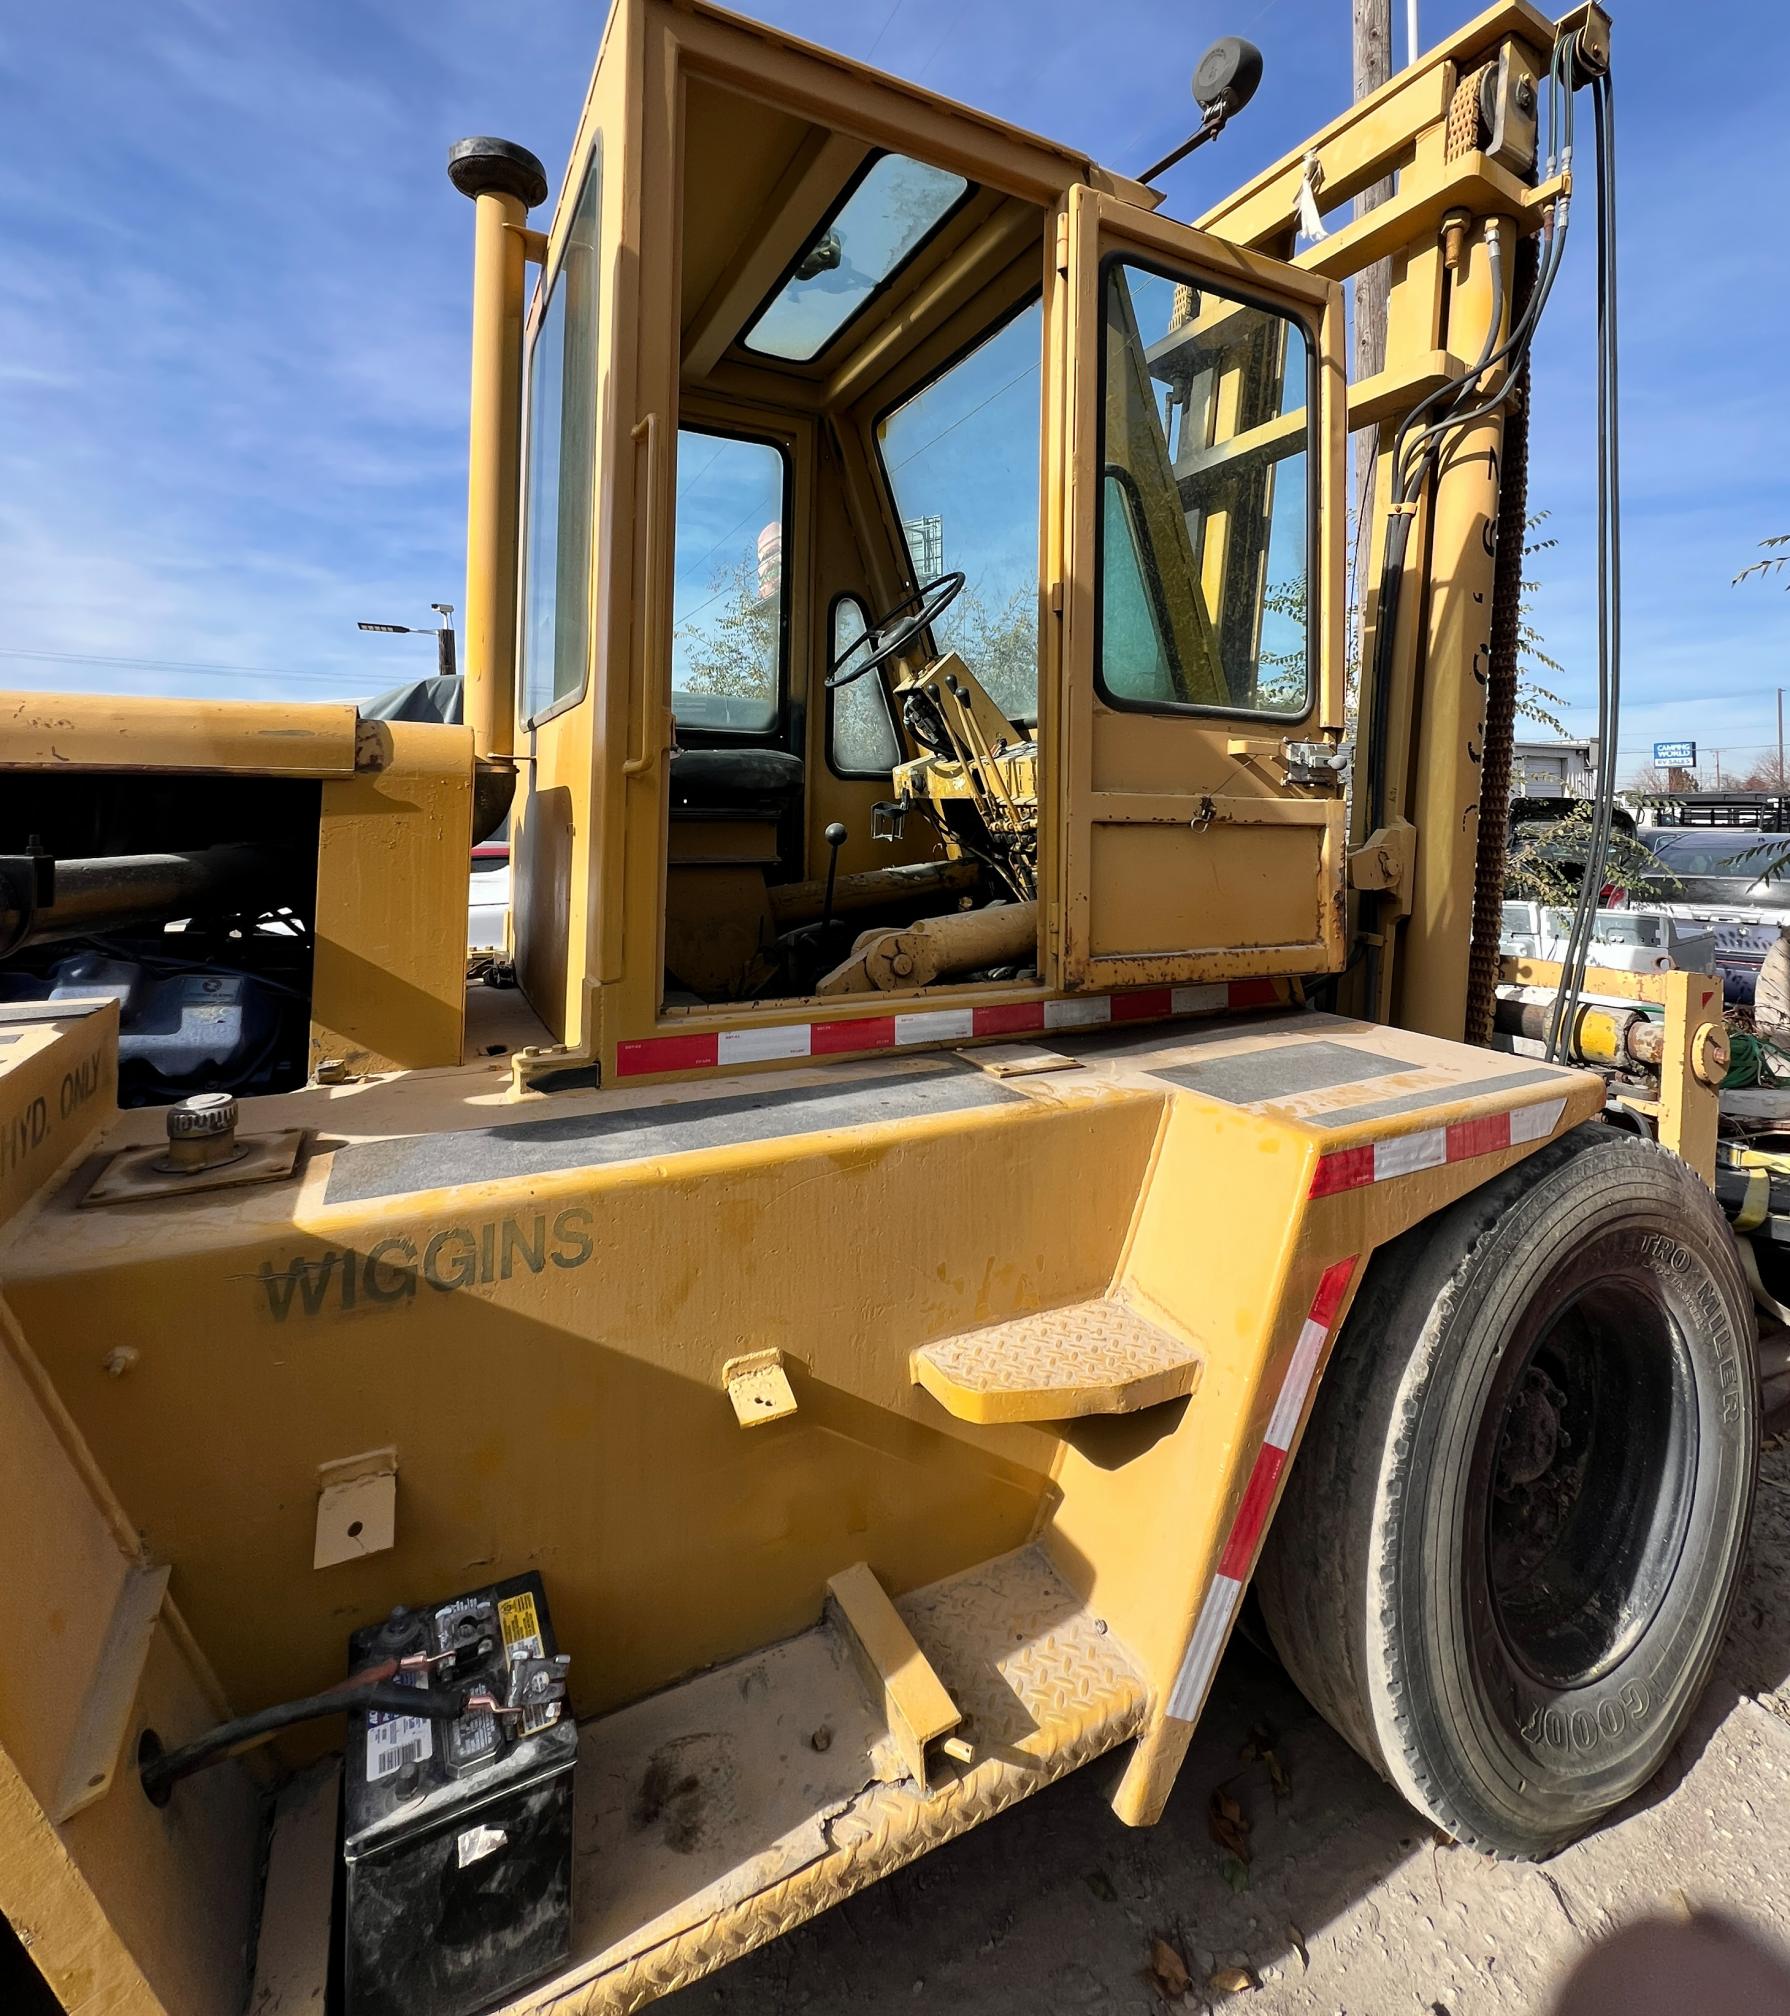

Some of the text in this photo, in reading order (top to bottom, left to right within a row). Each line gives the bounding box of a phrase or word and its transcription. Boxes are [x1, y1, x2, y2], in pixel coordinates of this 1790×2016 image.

[1657, 743, 1691, 752] CAMPING
[60, 1048, 101, 1121] ONLY
[260, 1207, 594, 1323] WIGGINS
[1696, 1279, 1741, 1424] MILER
